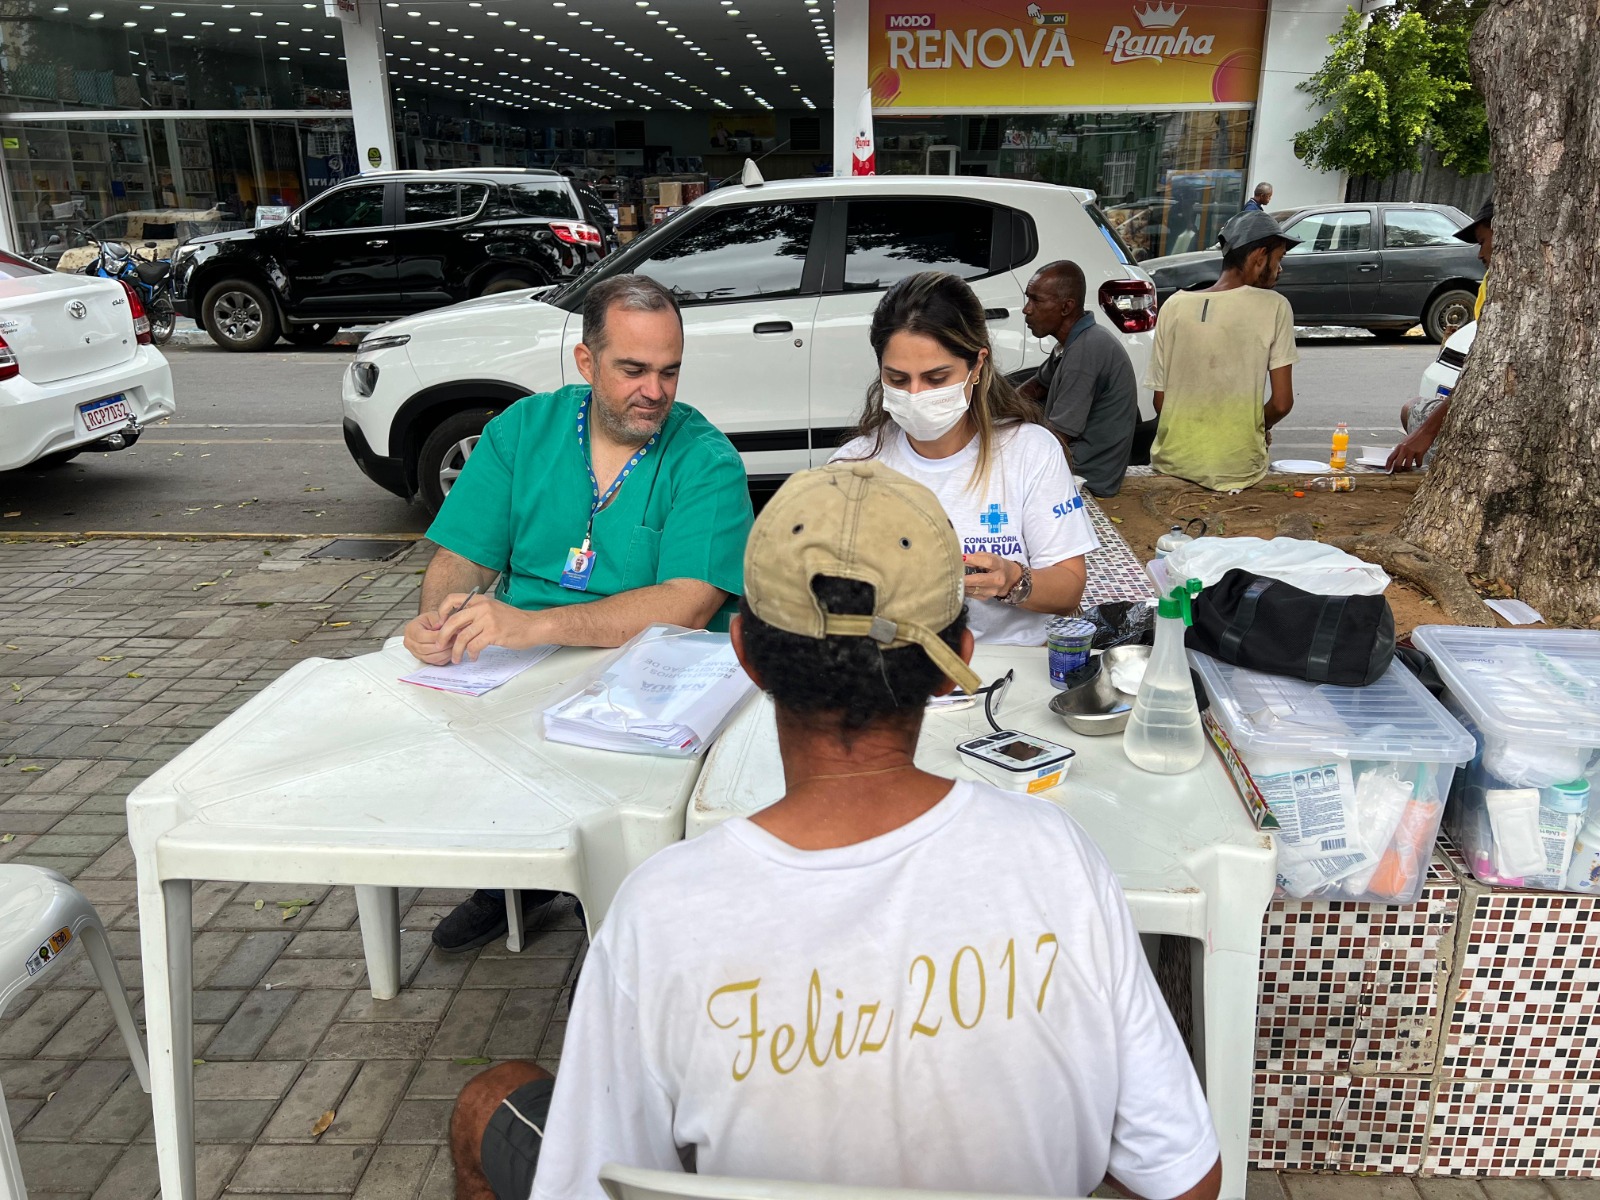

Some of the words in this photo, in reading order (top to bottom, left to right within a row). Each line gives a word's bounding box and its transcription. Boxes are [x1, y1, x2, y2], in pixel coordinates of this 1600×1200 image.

[890, 15, 932, 27] MODO
[887, 28, 1075, 69] RENOVA
[1104, 25, 1216, 63] Rainha
[87, 403, 128, 426] RCP7D32
[1052, 499, 1073, 519] SUS
[963, 544, 987, 555] NA
[991, 543, 1022, 556] RUA
[964, 535, 1018, 544] CONSULTÓRI
[706, 968, 895, 1082] Feliz
[908, 933, 1060, 1040] 2017
